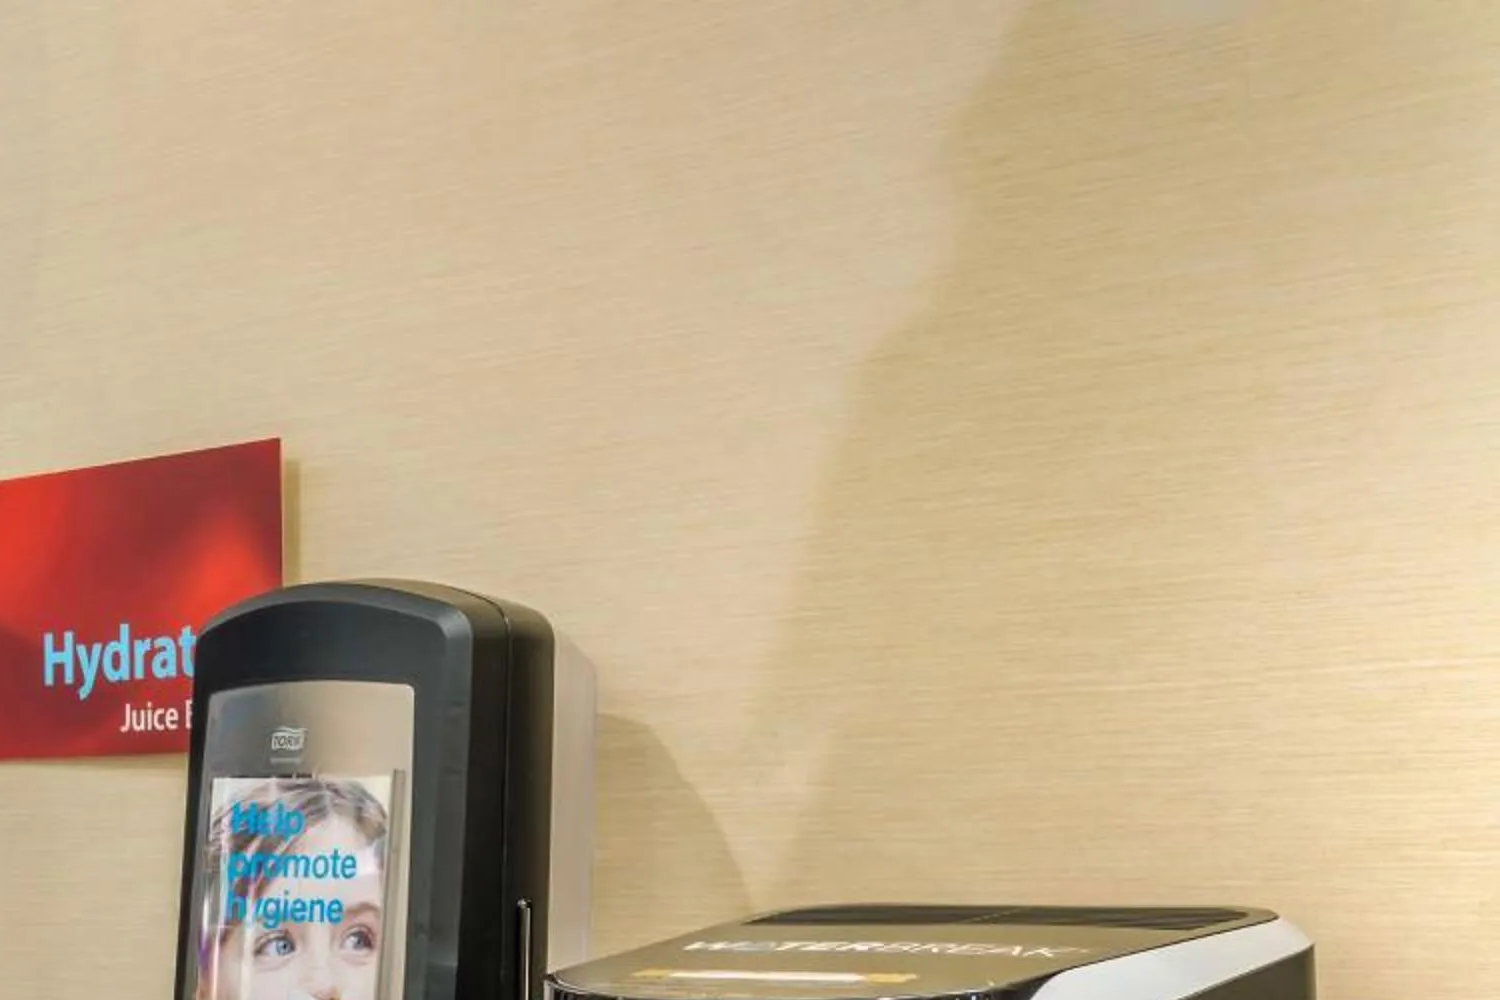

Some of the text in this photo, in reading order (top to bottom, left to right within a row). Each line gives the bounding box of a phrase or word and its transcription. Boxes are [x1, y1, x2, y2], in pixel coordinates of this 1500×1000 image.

[120, 702, 179, 733] Juice
[229, 801, 306, 843] Help
[227, 848, 357, 888] promote
